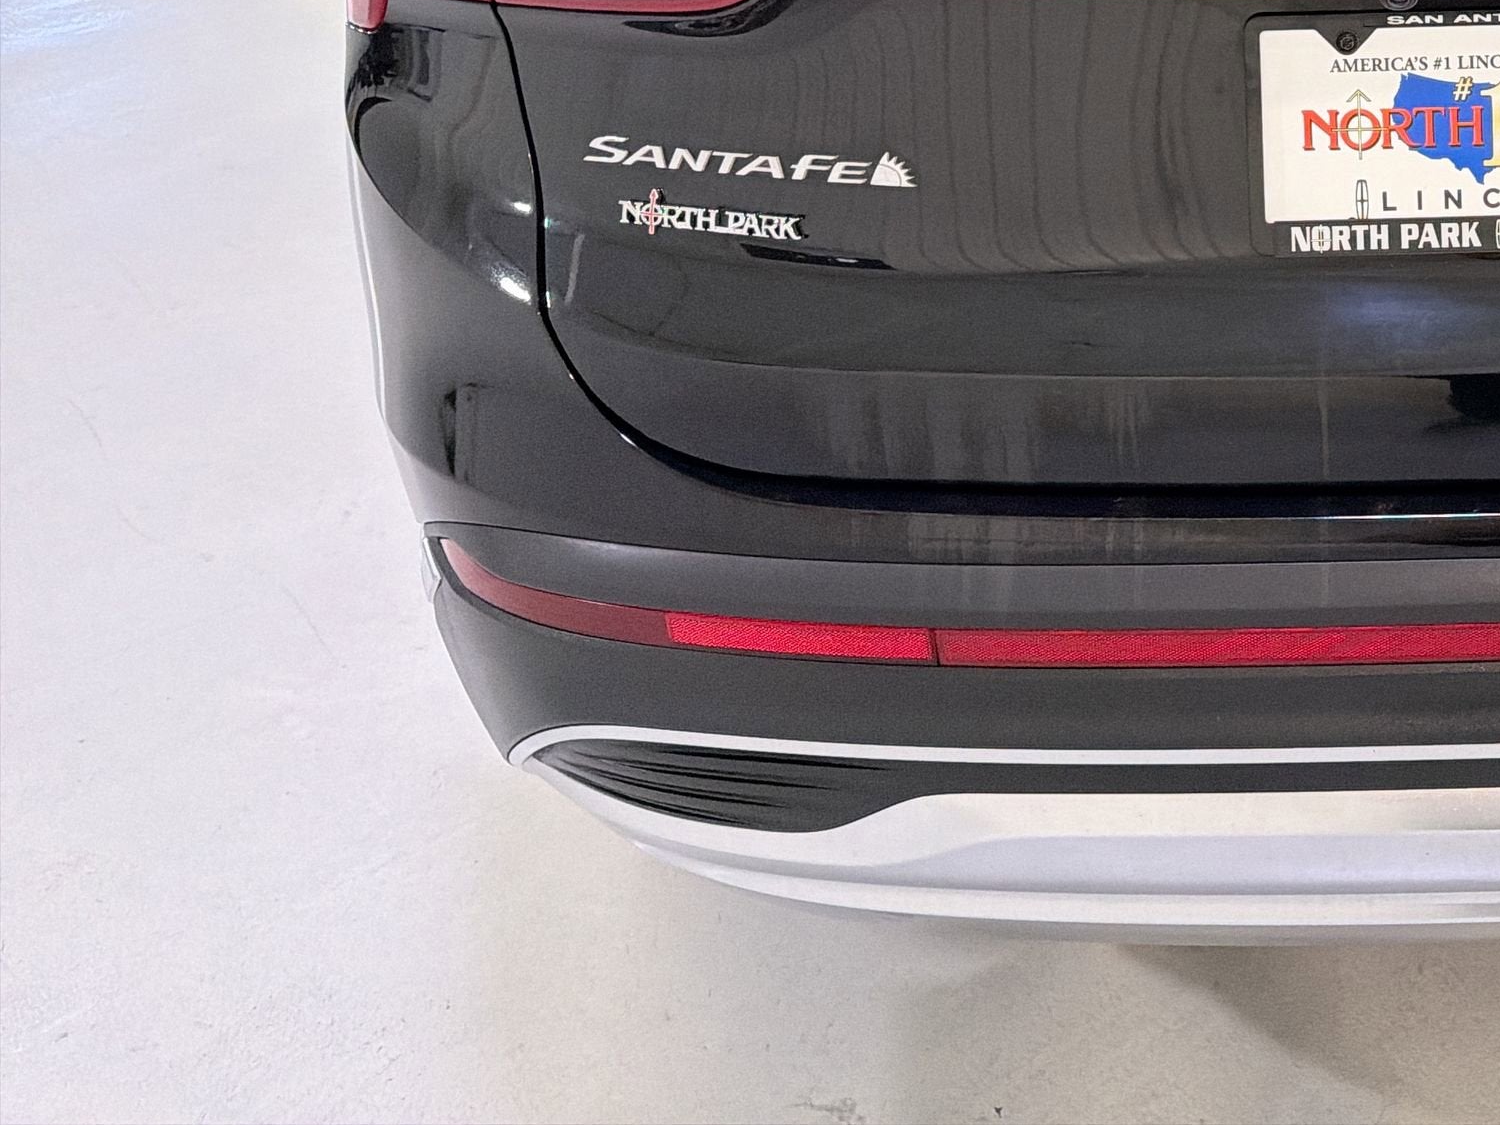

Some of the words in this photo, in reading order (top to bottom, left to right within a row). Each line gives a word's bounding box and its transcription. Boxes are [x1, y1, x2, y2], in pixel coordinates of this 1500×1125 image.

[1386, 13, 1444, 25] SAN
[1330, 56, 1428, 72] AMERICA'S
[1433, 53, 1452, 71] #1
[1301, 106, 1484, 151] NORTH
[618, 200, 720, 233] NORTH
[722, 211, 802, 240] PARK
[1290, 224, 1389, 253] NORTH
[1400, 221, 1482, 248] PARK
